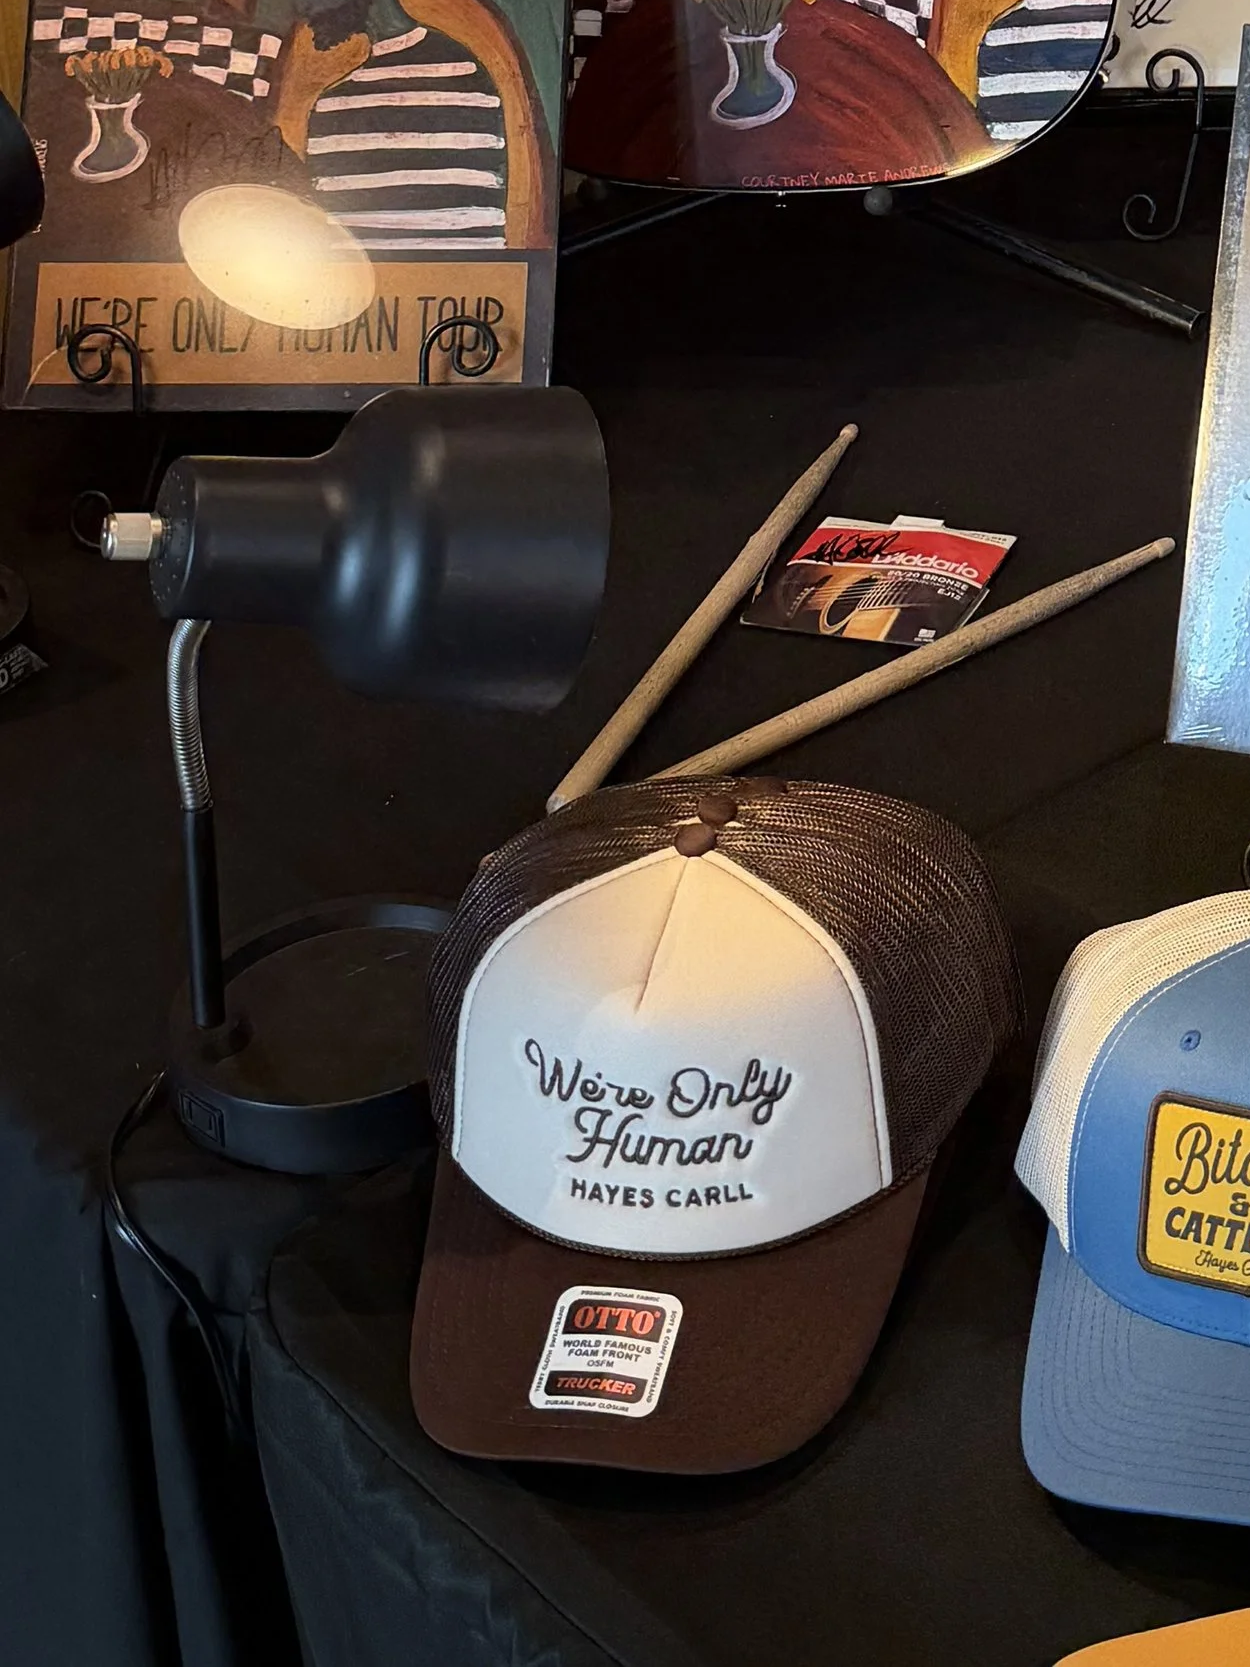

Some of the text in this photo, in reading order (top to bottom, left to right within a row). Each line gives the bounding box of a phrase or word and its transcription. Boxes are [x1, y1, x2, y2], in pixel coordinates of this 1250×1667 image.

[417, 296, 504, 352] TOUR
[922, 575, 969, 591] BRONZE
[667, 1058, 792, 1125] Only
[566, 1106, 753, 1168] Human
[570, 1178, 753, 1208] HAYES CARLL
[1230, 1192, 1250, 1217] &
[1195, 1250, 1239, 1273] Hayes
[563, 1339, 651, 1355] WORLD FAMOUS
[568, 1349, 641, 1362] FOAM FRONT
[556, 1377, 636, 1395] TRUCKER
